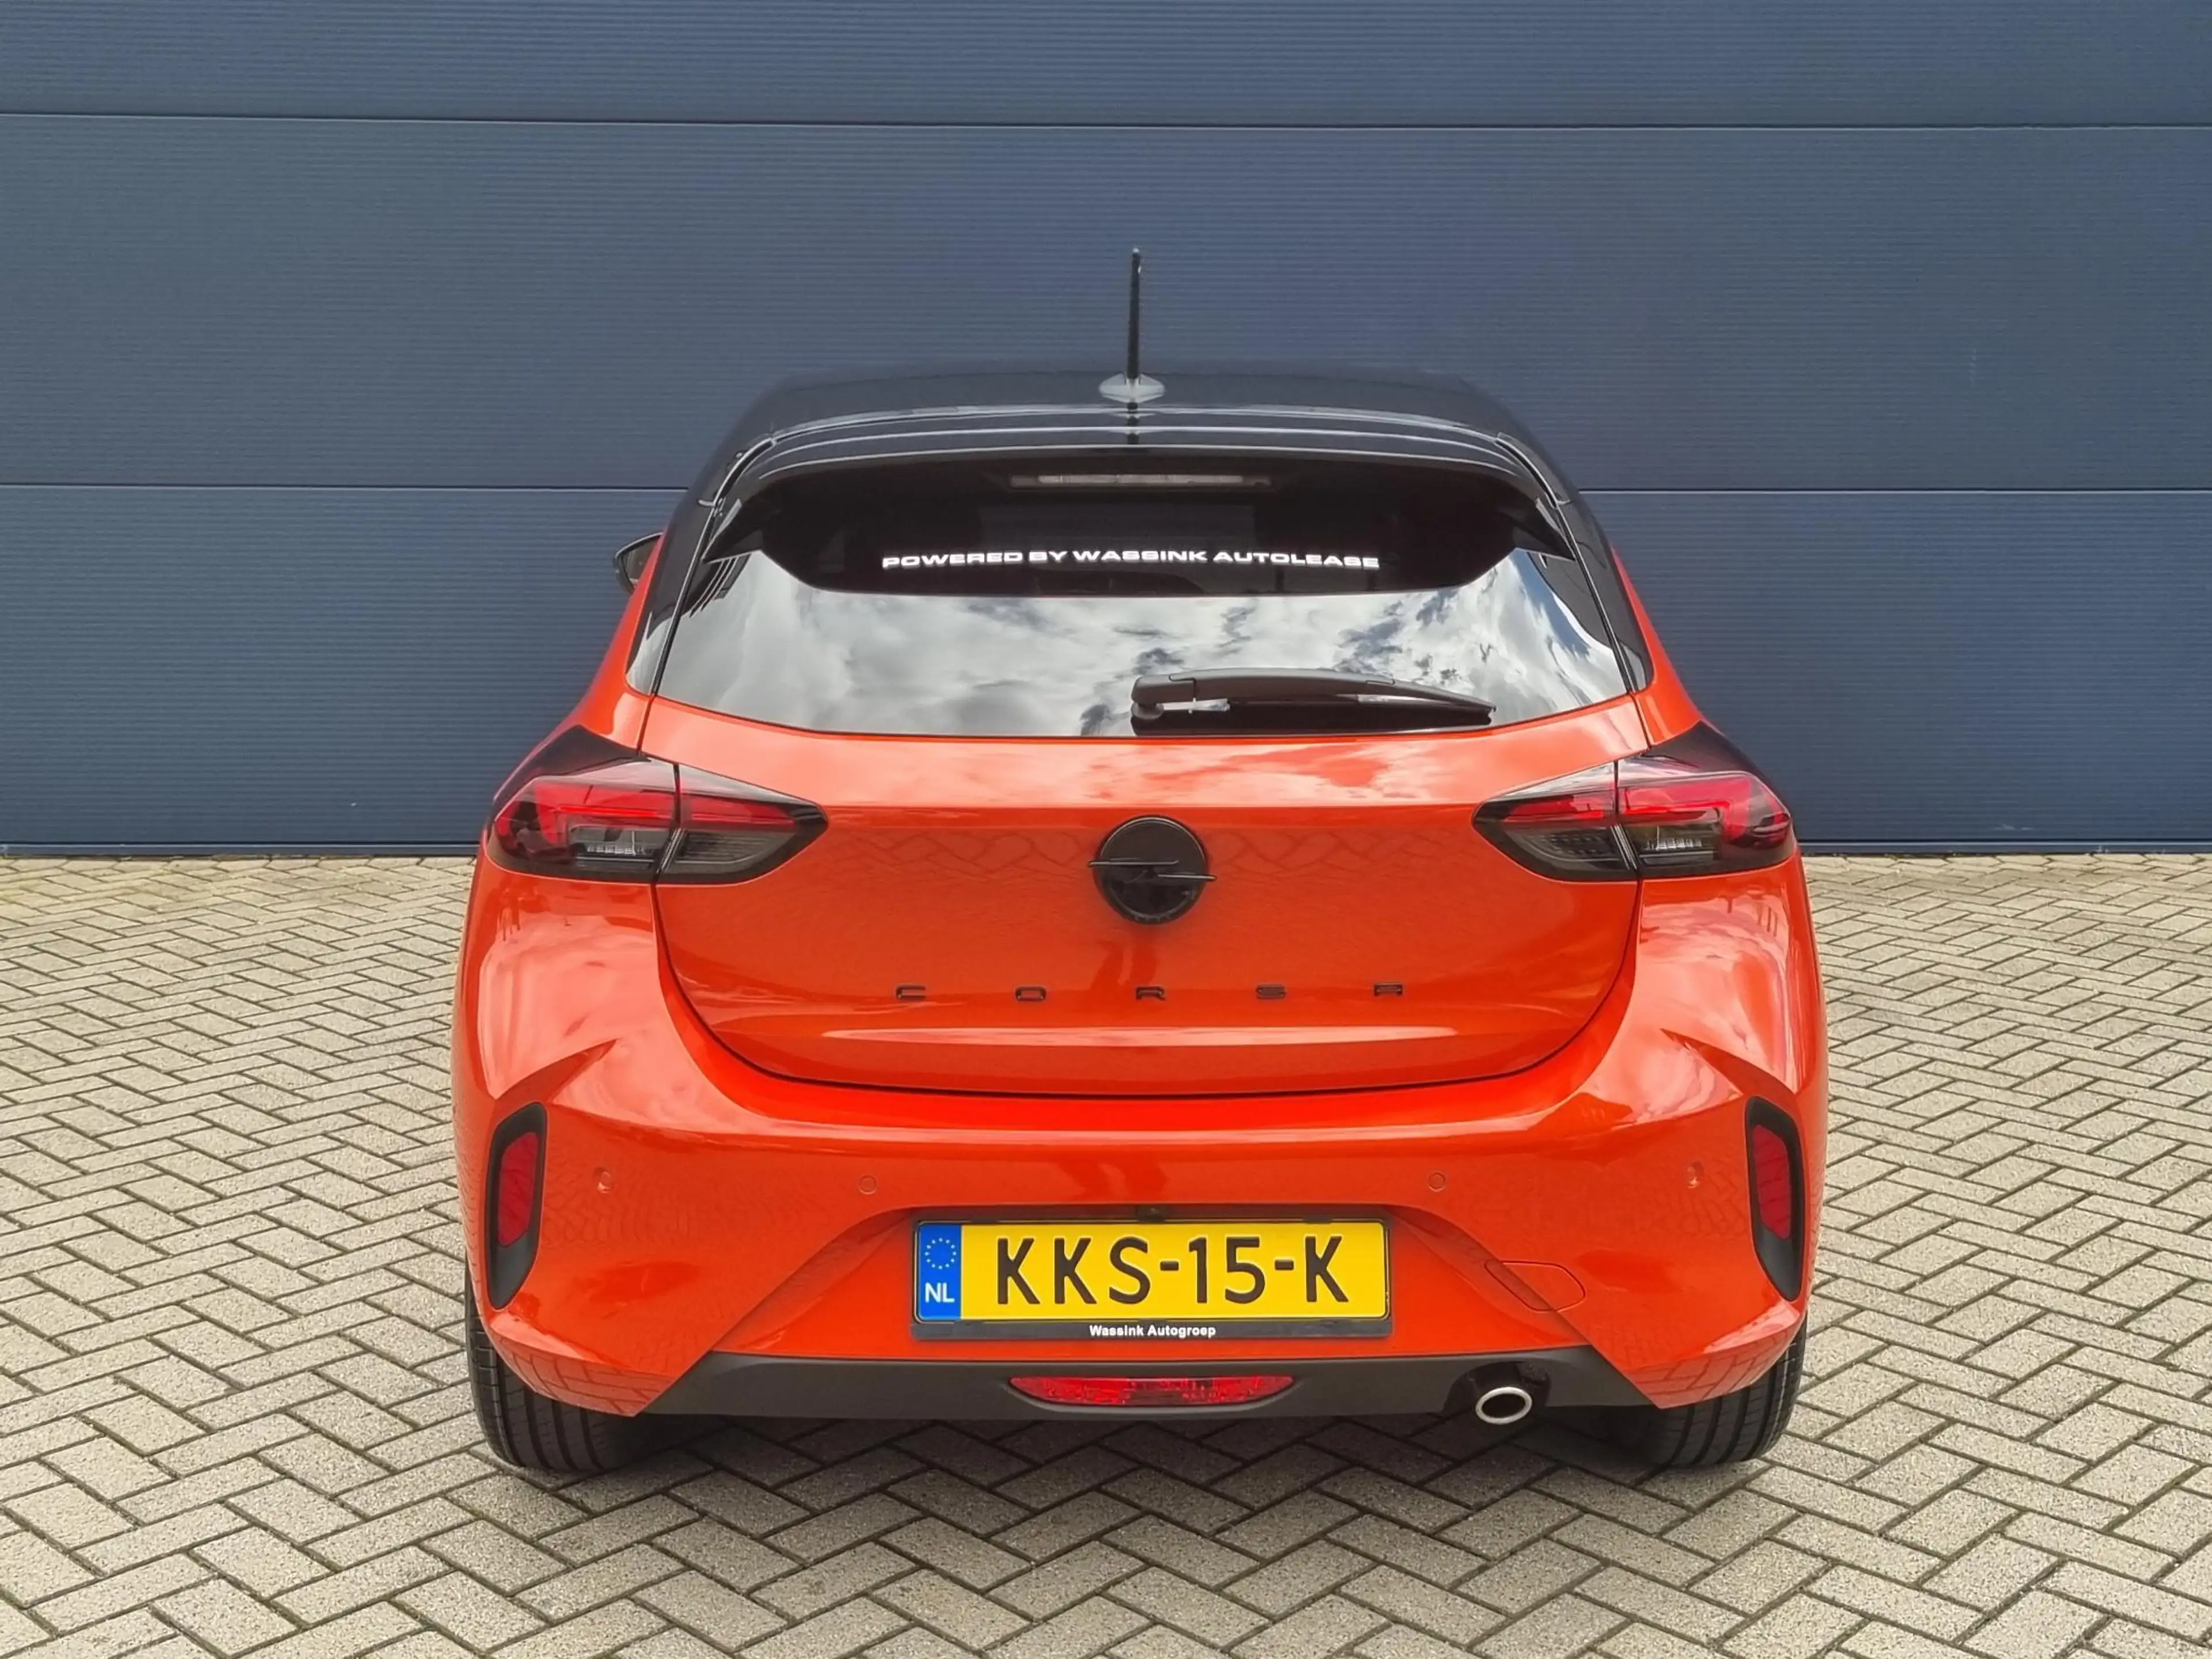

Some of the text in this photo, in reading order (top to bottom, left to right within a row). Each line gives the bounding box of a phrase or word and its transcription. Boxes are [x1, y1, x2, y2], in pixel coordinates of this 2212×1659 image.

[882, 550, 1381, 569] POWERED BY WASSINK AUTOLEASE
[895, 984, 1404, 1002] CORSA
[997, 1236, 1349, 1306] KKS-15-K
[925, 1282, 955, 1303] NL
[1089, 1324, 1217, 1339] Wassink Autogroep
